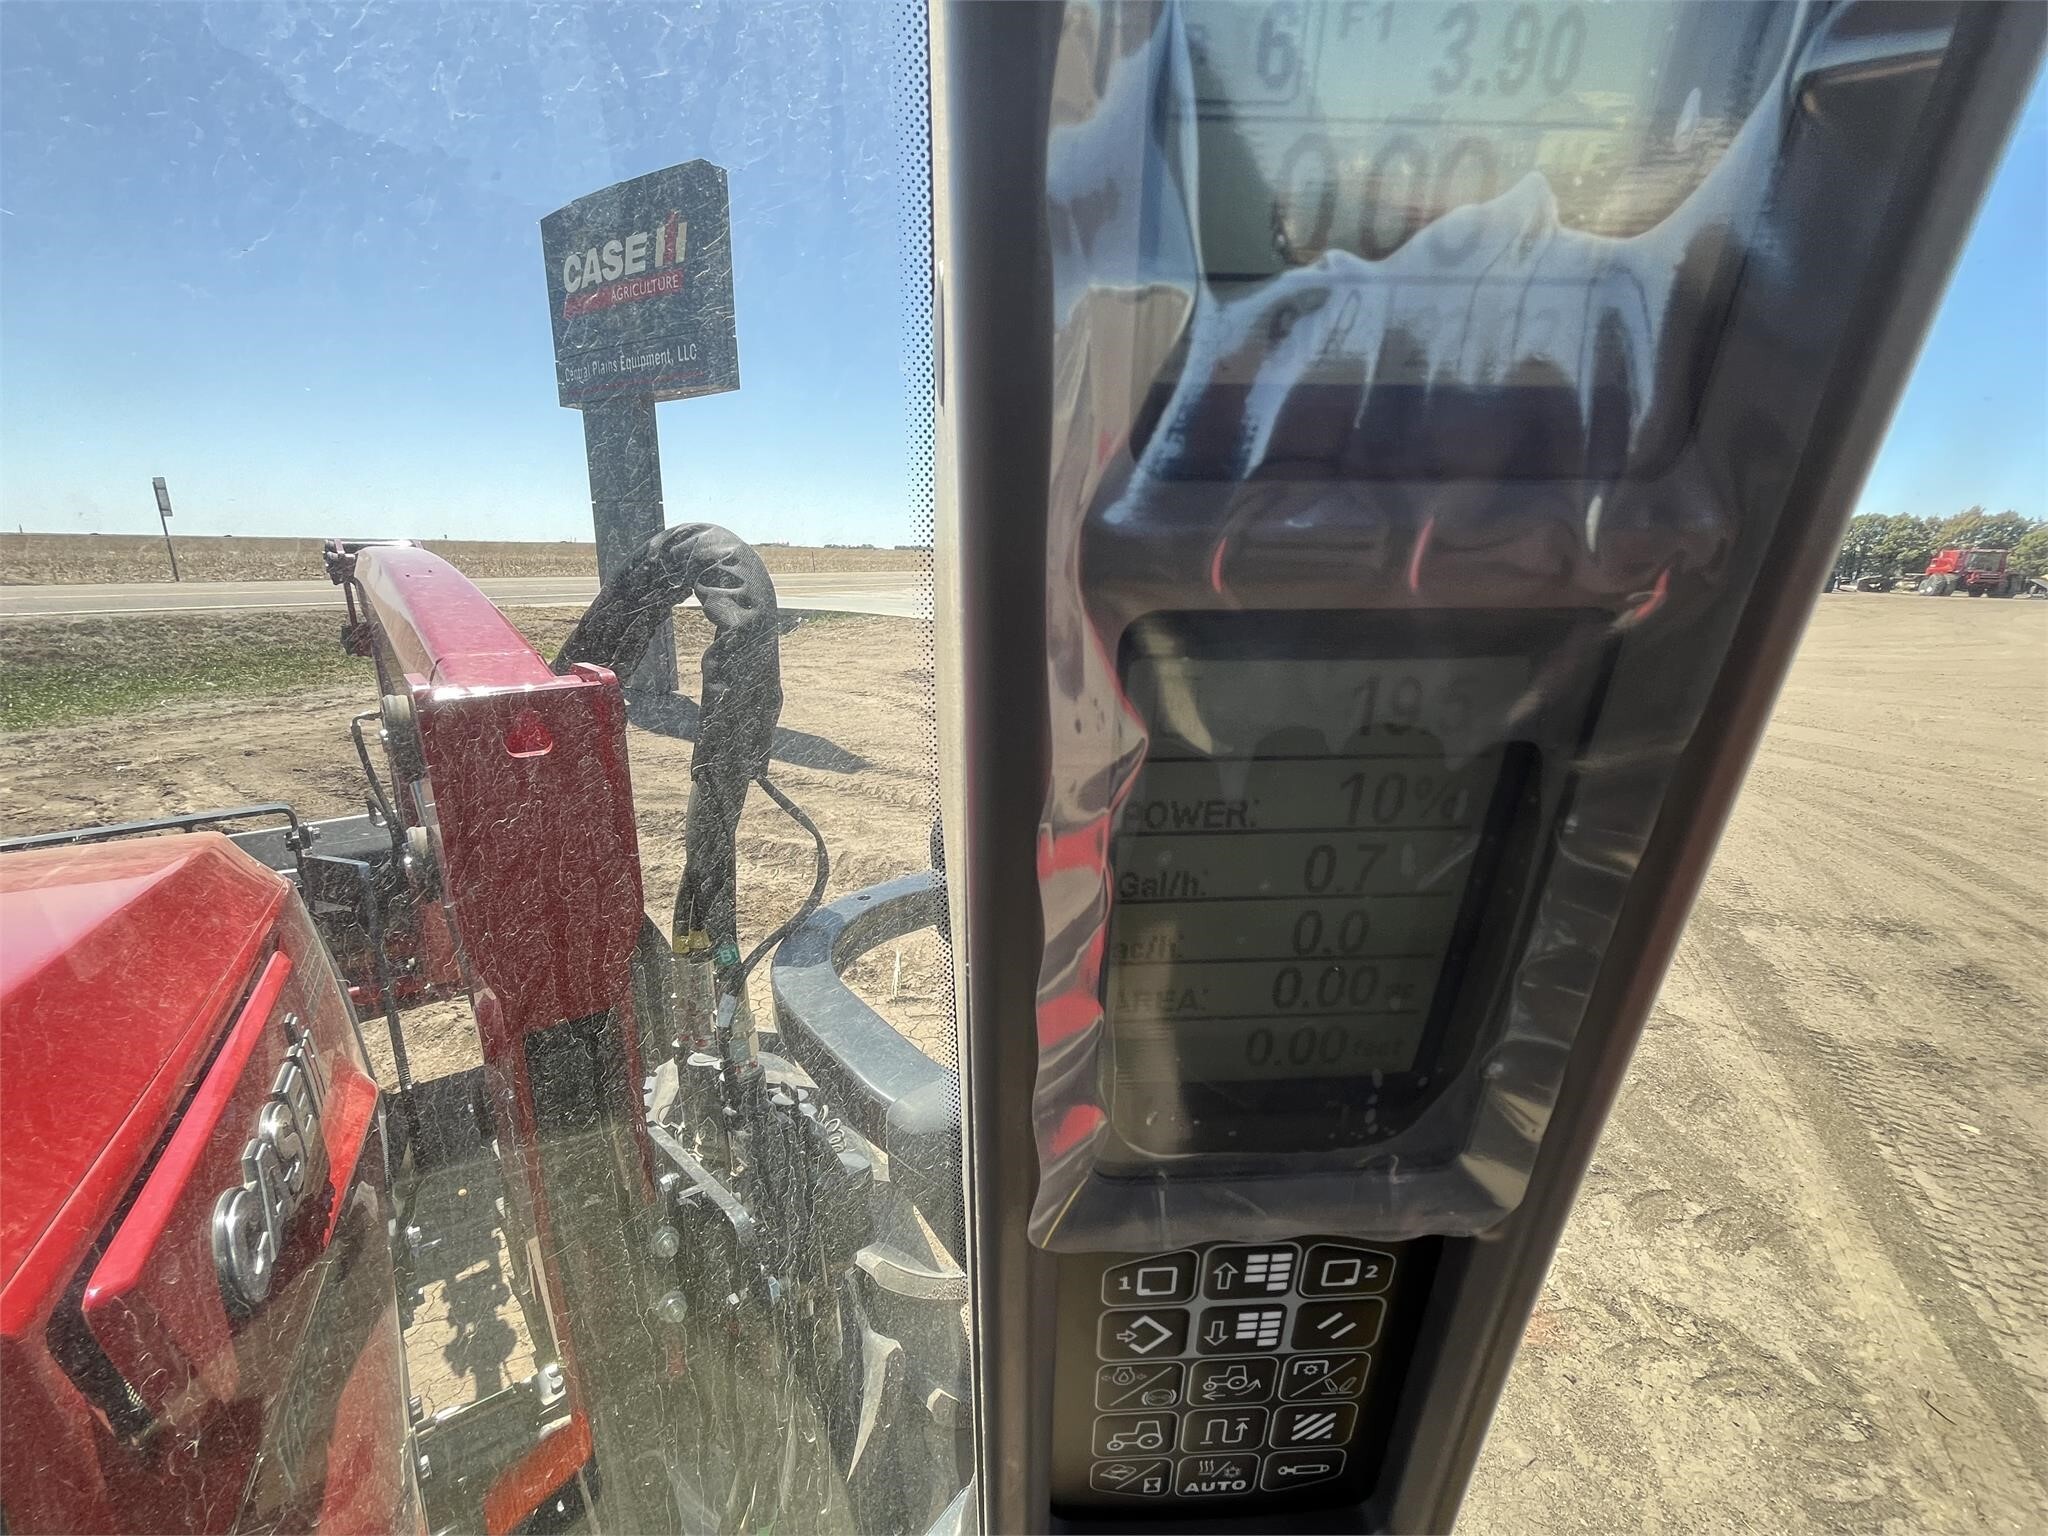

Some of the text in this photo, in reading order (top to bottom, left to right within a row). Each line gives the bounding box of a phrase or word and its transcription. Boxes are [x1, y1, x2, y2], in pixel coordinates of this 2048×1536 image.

[563, 232, 647, 293] CASE
[611, 274, 679, 302] AGRICULTURE
[565, 343, 698, 382] Central Plains Equipment, LLC
[1303, 843, 1388, 895] 0.7
[1291, 909, 1371, 957] 0.0
[1272, 965, 1380, 1009] 0.00
[1246, 1026, 1350, 1068] 0.00
[1118, 1276, 1132, 1291] 1
[1364, 1265, 1379, 1279] 2
[1184, 1480, 1247, 1493] AUTO
